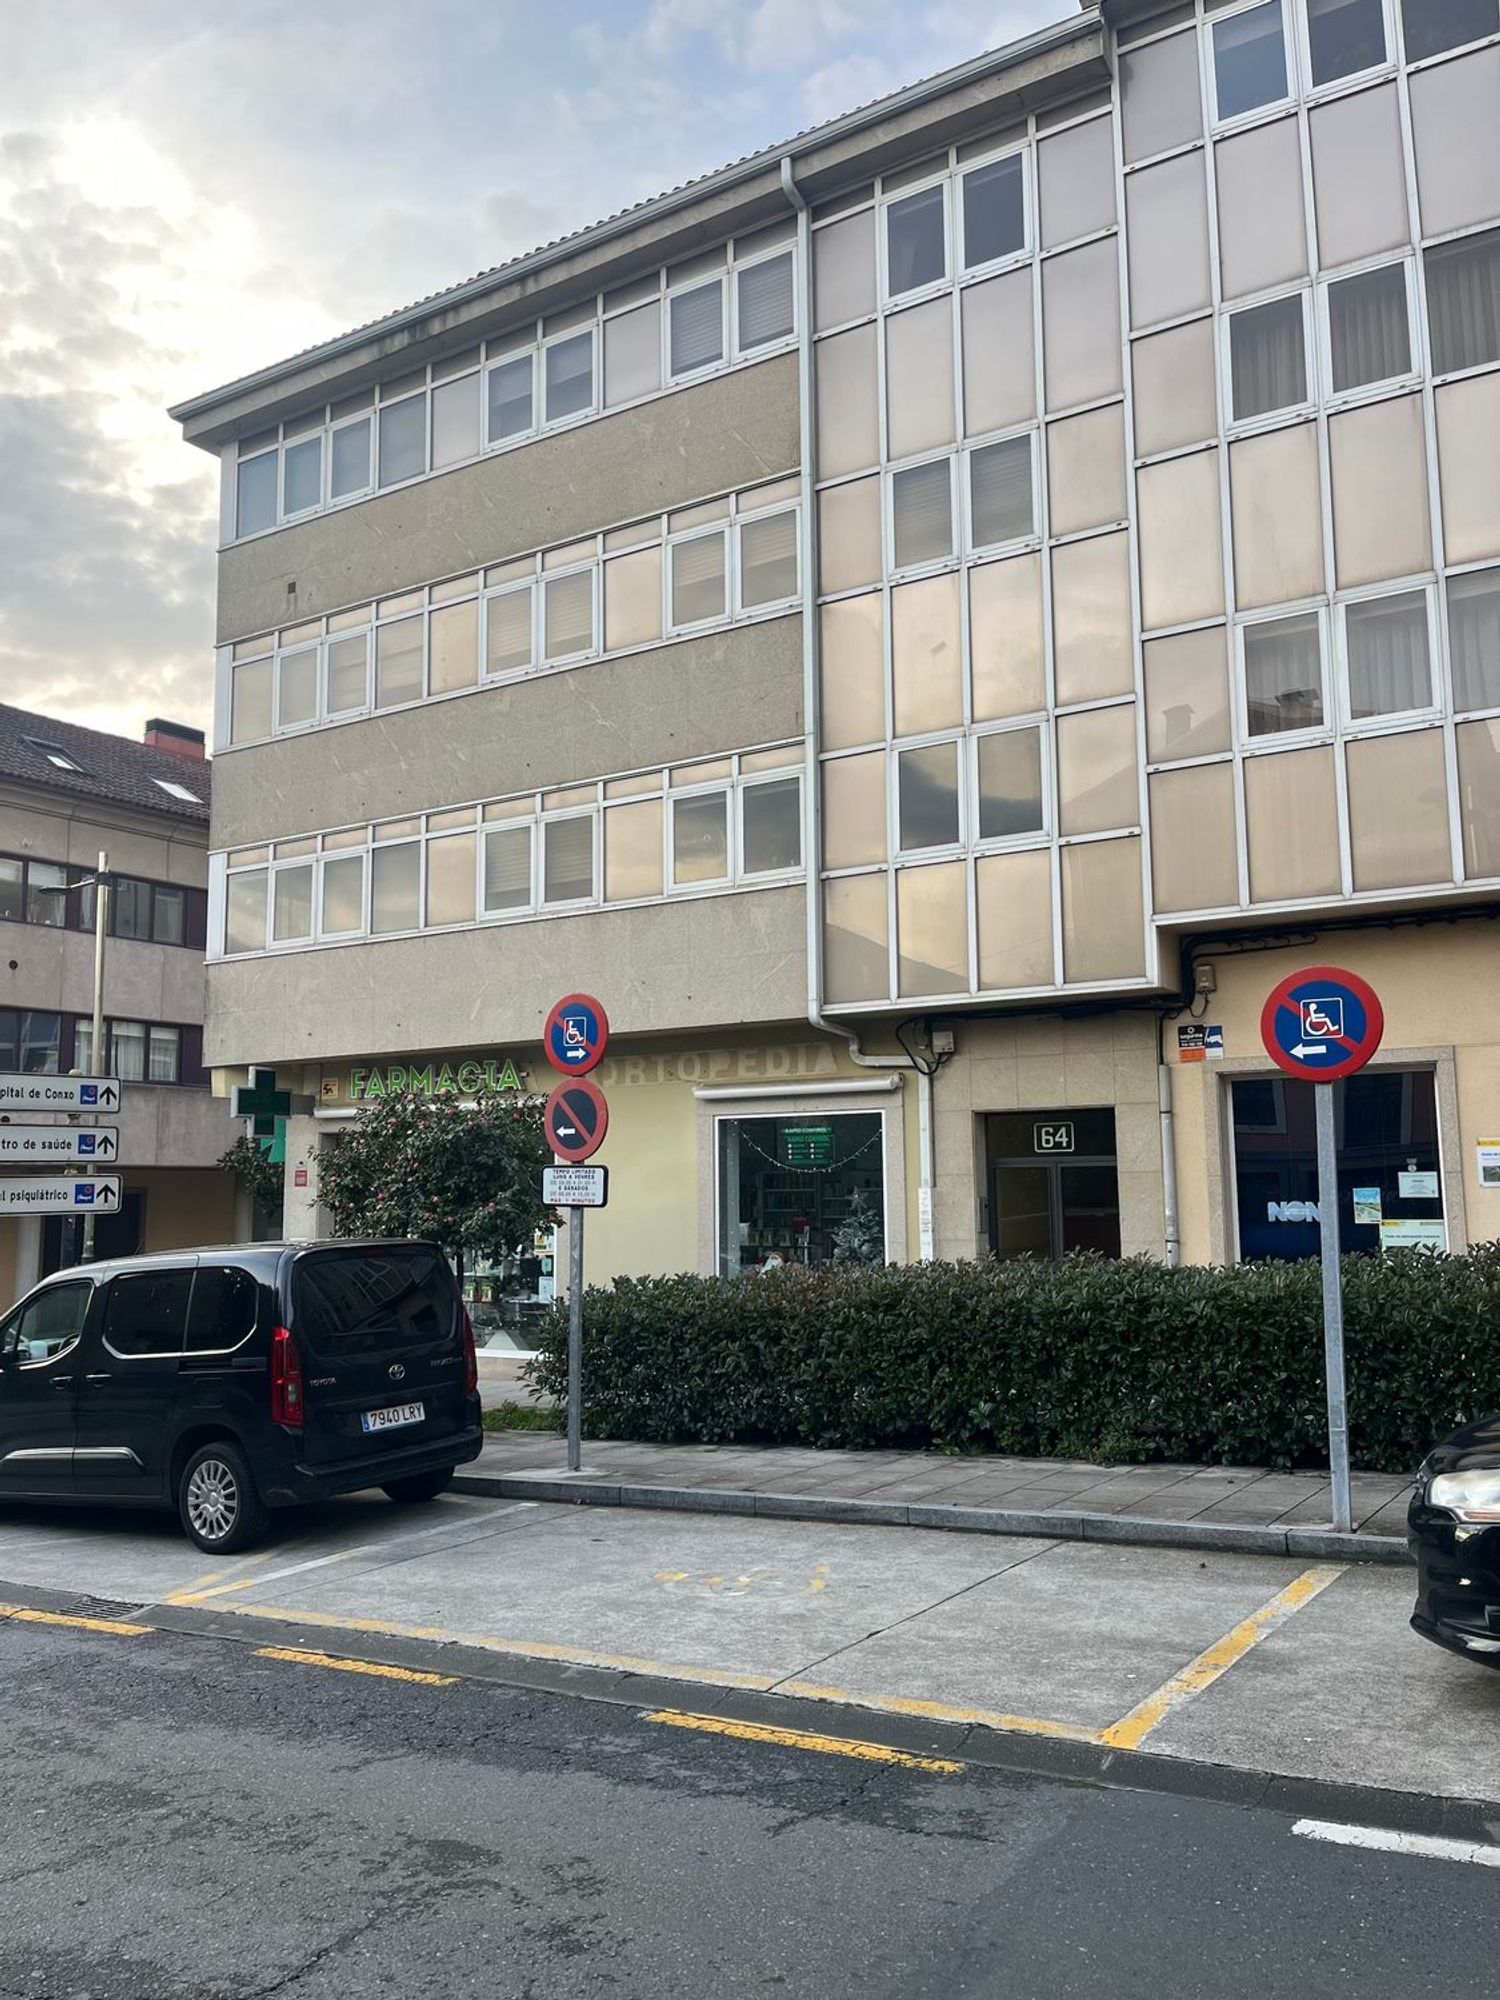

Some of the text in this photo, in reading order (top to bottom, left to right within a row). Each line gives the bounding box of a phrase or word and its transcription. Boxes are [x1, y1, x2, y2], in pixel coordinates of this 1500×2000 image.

[351, 1058, 522, 1099] FARMACIA
[29, 1088, 41, 1099] de
[45, 1088, 75, 1100] Conxo
[1041, 1126, 1068, 1148] 64
[23, 1140, 36, 1150] de
[41, 1138, 73, 1150] saúde
[10, 1191, 68, 1203] psiquiátrico
[309, 1376, 337, 1387] TOYOTA
[370, 1403, 423, 1428] 7940 LRY
